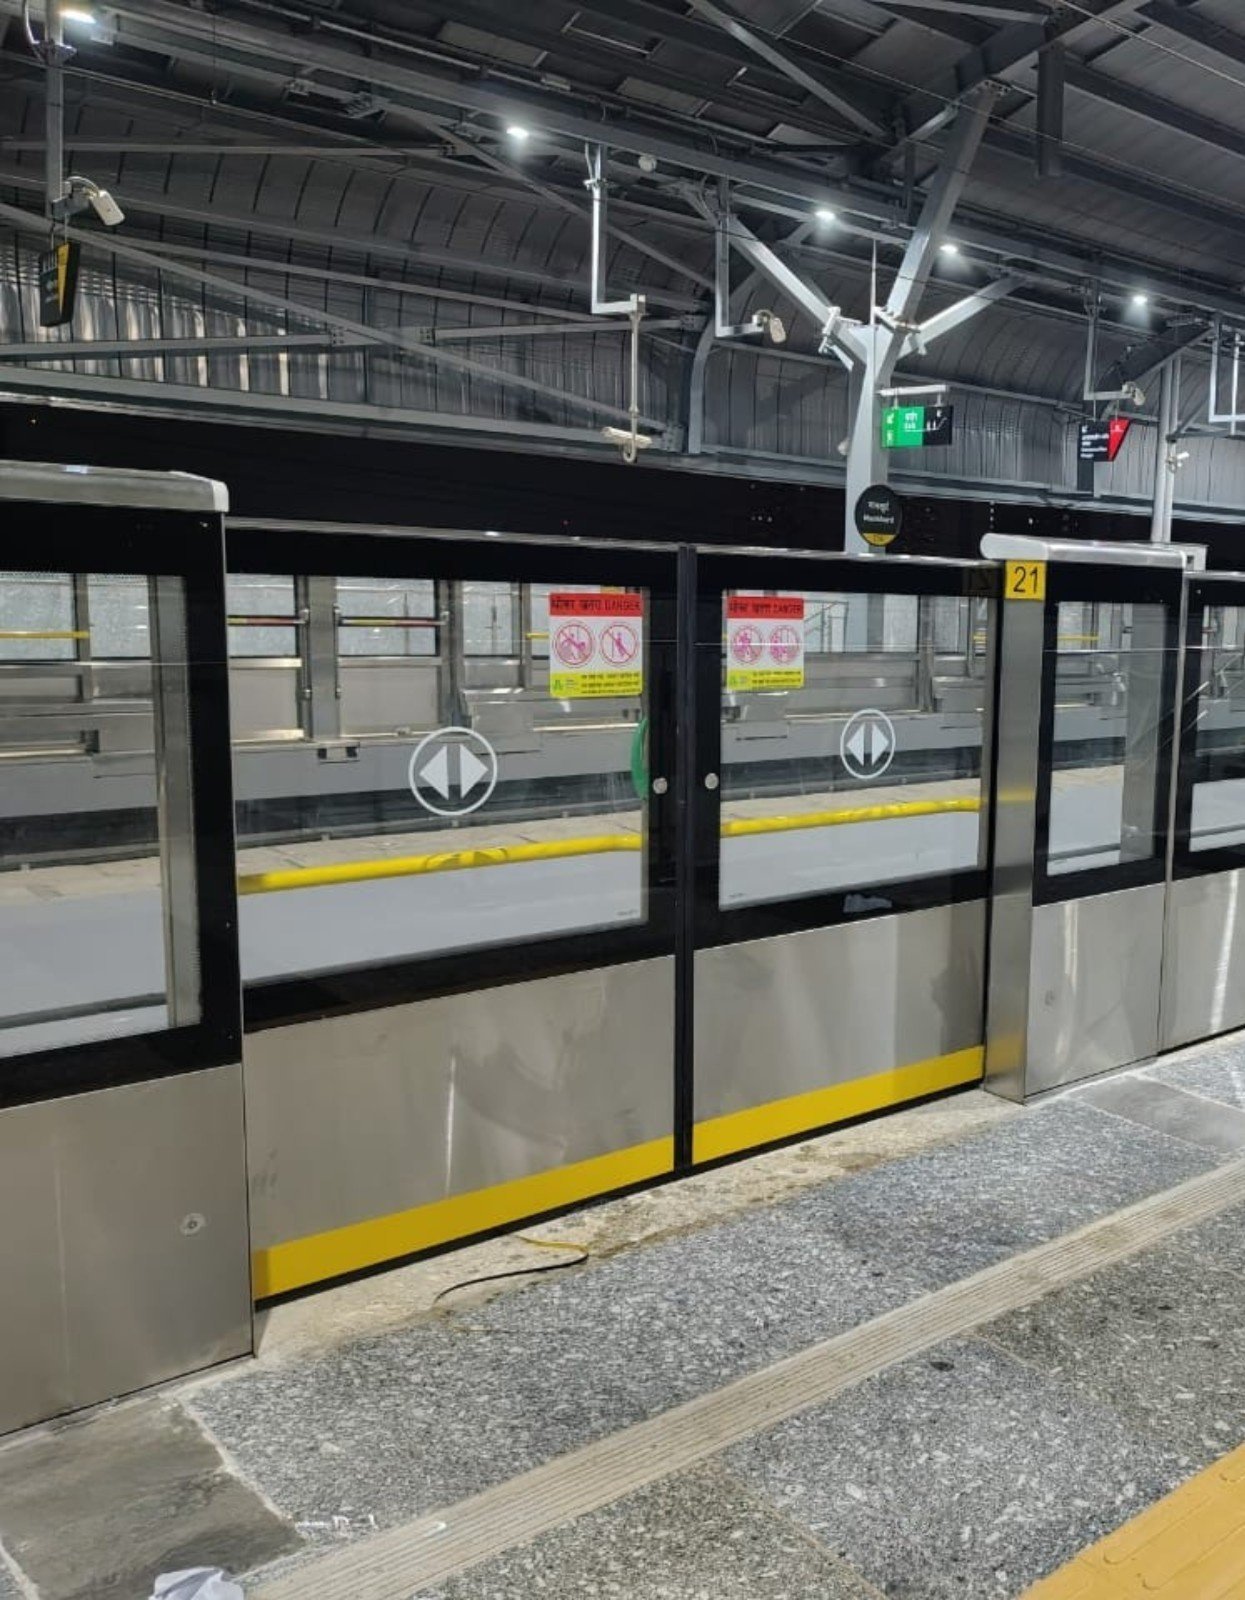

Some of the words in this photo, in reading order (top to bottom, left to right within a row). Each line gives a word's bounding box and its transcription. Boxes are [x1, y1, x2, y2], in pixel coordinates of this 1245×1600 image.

[1013, 566, 1039, 594] 21
[604, 600, 640, 611] DANGER
[773, 604, 802, 614] DANGER
